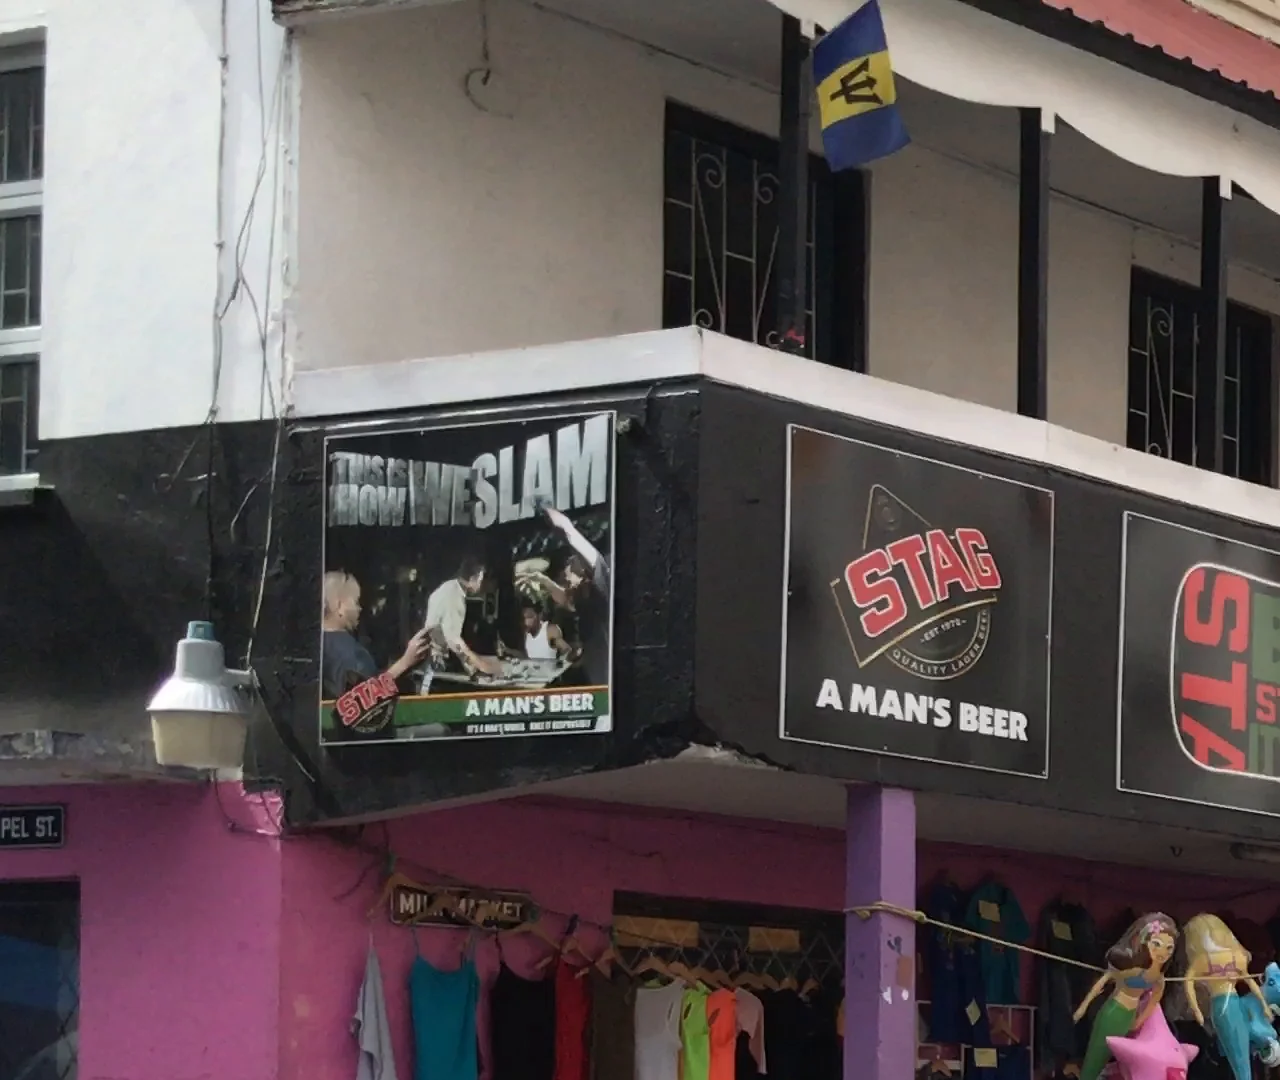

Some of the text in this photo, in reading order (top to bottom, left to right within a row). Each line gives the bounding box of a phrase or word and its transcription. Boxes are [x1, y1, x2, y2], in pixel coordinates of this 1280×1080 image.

[330, 451, 407, 486] THIS IS
[408, 414, 609, 529] WE SLAM
[329, 483, 407, 528] HOW
[845, 527, 1002, 638] STAG
[892, 649, 947, 675] QUALITY
[465, 693, 594, 717] A MAN'S BEER
[815, 678, 1029, 742] A MAN'S BEER
[0, 815, 58, 838] PEL ST.
